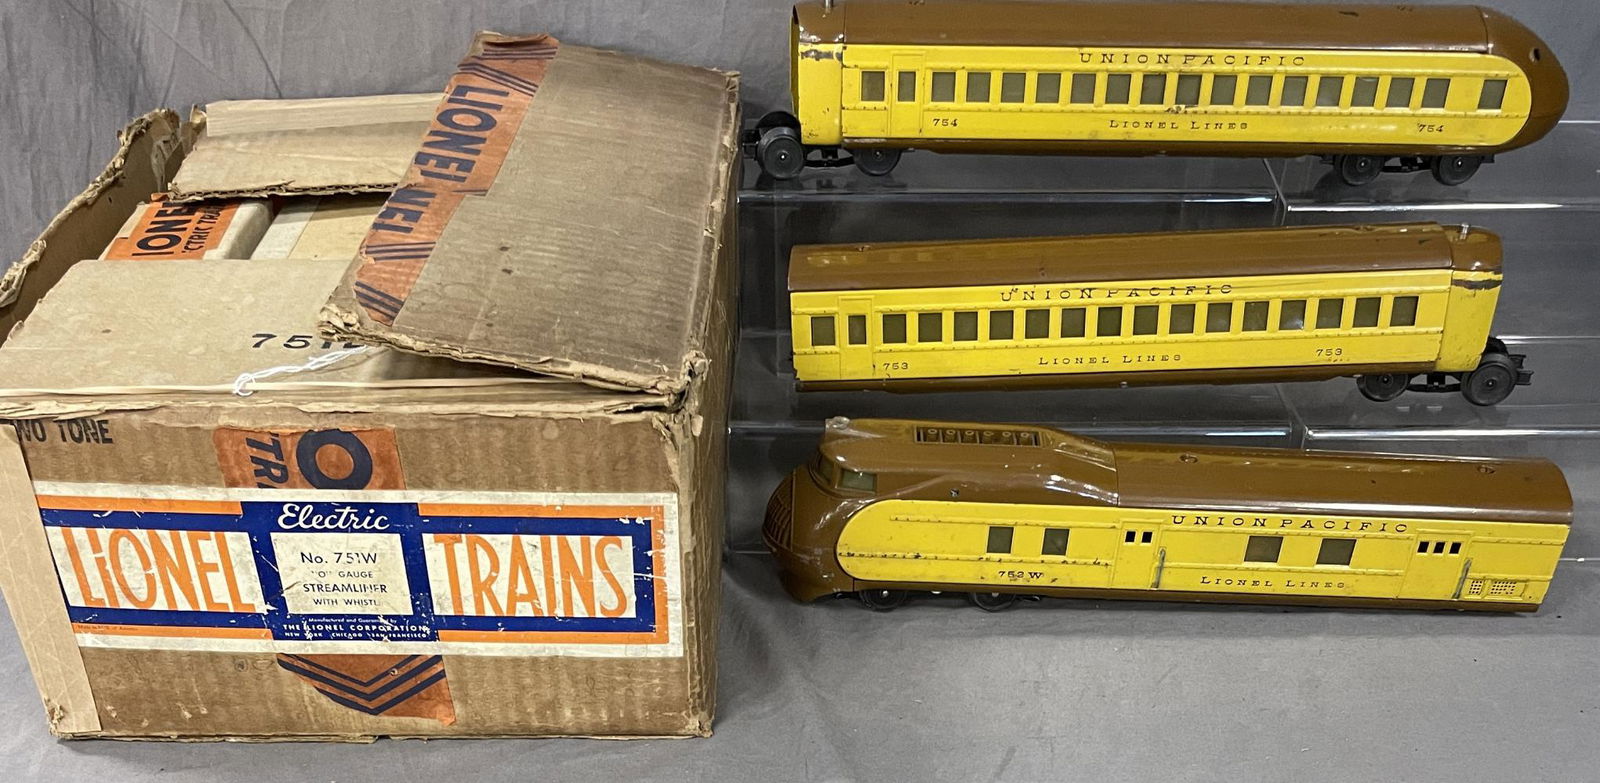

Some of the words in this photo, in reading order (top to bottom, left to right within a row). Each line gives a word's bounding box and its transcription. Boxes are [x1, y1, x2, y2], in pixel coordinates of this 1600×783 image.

[1079, 52, 1170, 65] UNION
[1181, 54, 1306, 67] PACIFIC
[932, 118, 959, 128] 754
[1108, 119, 1179, 130] LIONEL
[1190, 120, 1249, 131] LINES
[1417, 123, 1445, 133] 754
[182, 226, 214, 253] CTRIC
[1000, 288, 1096, 302] UNION
[1106, 284, 1233, 298] PACIFIC
[1315, 347, 1344, 357] 753
[882, 362, 909, 371] 753
[1038, 356, 1110, 366] LIONEL
[1121, 354, 1182, 364] LINES
[57, 418, 114, 444] TONE
[277, 502, 391, 531] Electric
[1171, 514, 1268, 528] UNION
[1279, 518, 1408, 533] PACIFIC
[300, 551, 328, 564] No.
[333, 552, 377, 565] 751W
[60, 526, 257, 613] LIONEL
[432, 533, 628, 618] TRAINS
[338, 570, 374, 579] GAUGE
[1200, 575, 1273, 587] LIONEL
[1285, 579, 1346, 589] LINES
[312, 598, 338, 606] WITH
[342, 598, 383, 607] WHISTL
[349, 624, 426, 632] CORPORATION
